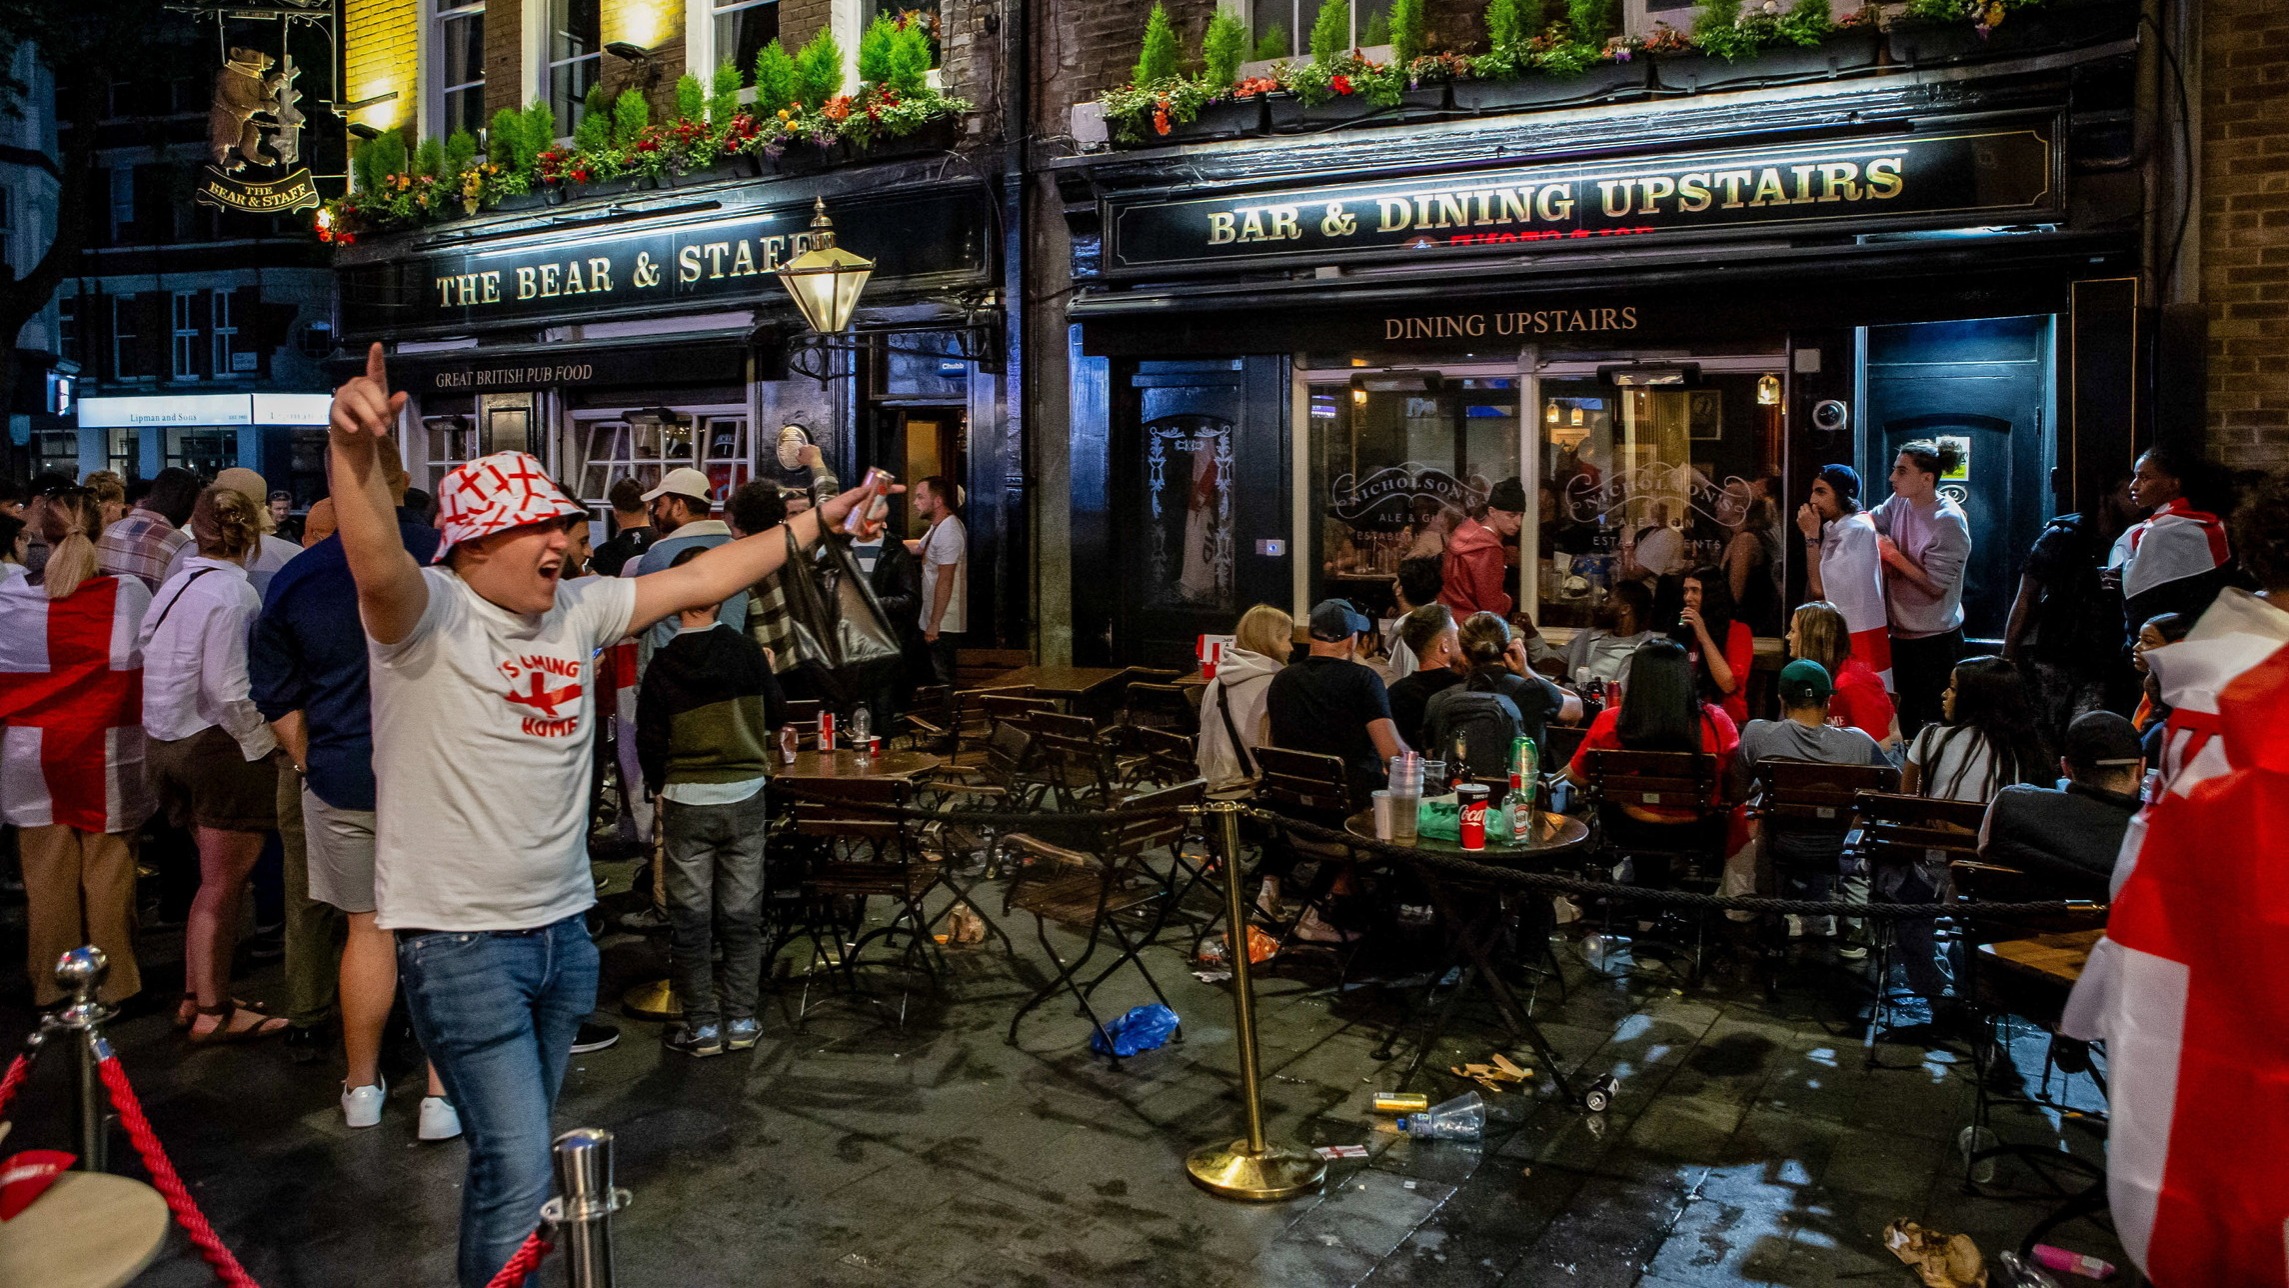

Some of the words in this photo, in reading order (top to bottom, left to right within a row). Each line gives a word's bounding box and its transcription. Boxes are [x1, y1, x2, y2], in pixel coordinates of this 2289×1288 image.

[208, 181, 246, 206] BEAR
[248, 196, 261, 207] &
[262, 183, 306, 207] STAFF
[245, 186, 273, 196] THE
[1207, 206, 1303, 245] BAR
[1320, 202, 1358, 238] &
[1376, 184, 1574, 233] DINING
[1597, 157, 1904, 218] UPSTAIRS
[436, 269, 500, 308] THE
[516, 257, 614, 300] BEAR
[632, 250, 661, 288] &
[1385, 314, 1486, 341] DINING
[1495, 306, 1638, 336] UPSTAIRS
[436, 371, 474, 388] GREAT
[476, 367, 524, 386] BRITISH
[526, 366, 552, 383] PUB
[554, 364, 593, 381] FOOD
[130, 414, 160, 423] Lipman
[161, 413, 176, 421] and
[178, 413, 197, 421] Sons
[1378, 514, 1402, 523] ALE
